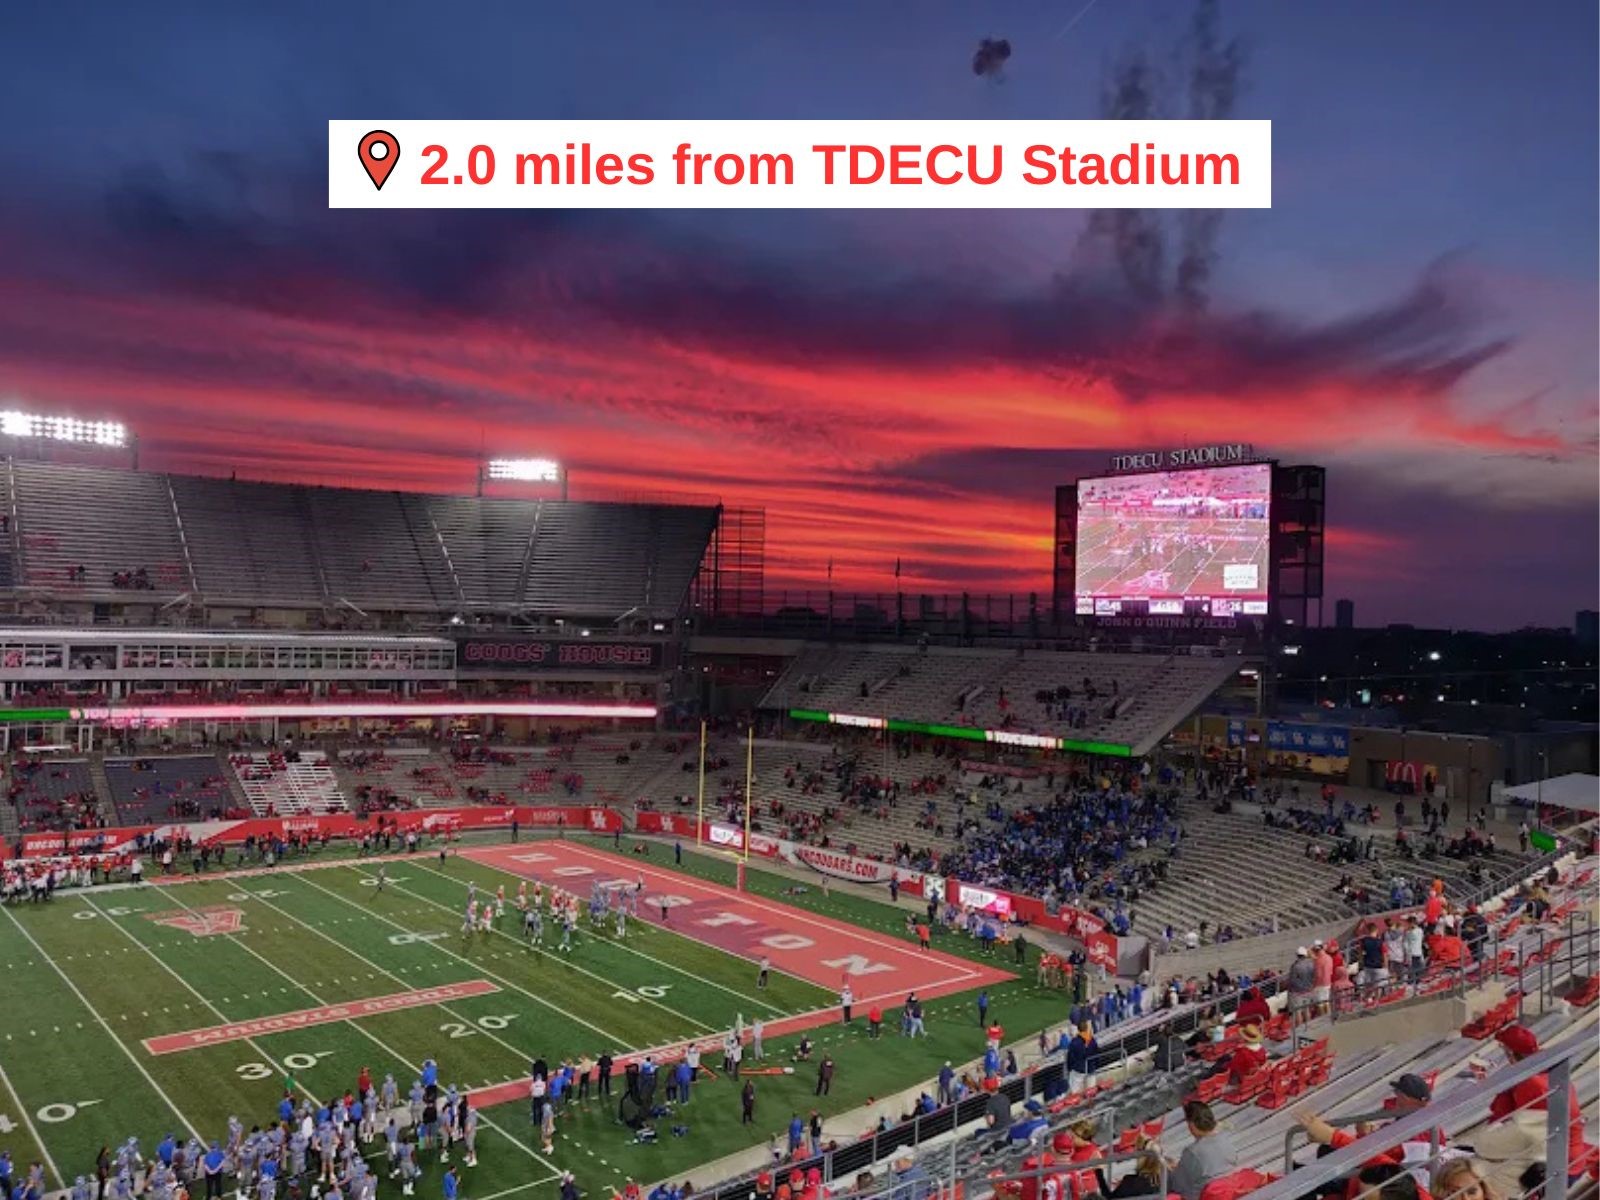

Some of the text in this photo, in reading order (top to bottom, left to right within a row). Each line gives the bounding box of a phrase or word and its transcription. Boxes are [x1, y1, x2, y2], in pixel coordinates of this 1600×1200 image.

[1113, 445, 1242, 470] TDECU STADIUM
[1097, 617, 1132, 628] JOHN
[1134, 617, 1191, 628] O'QUINN
[1194, 617, 1237, 628] FIELD
[464, 642, 651, 664] COOGS' HOUSE!
[612, 985, 666, 1003] 10
[191, 1008, 350, 1042] STADIUM
[440, 1016, 509, 1039] 20
[235, 1053, 317, 1080] 30
